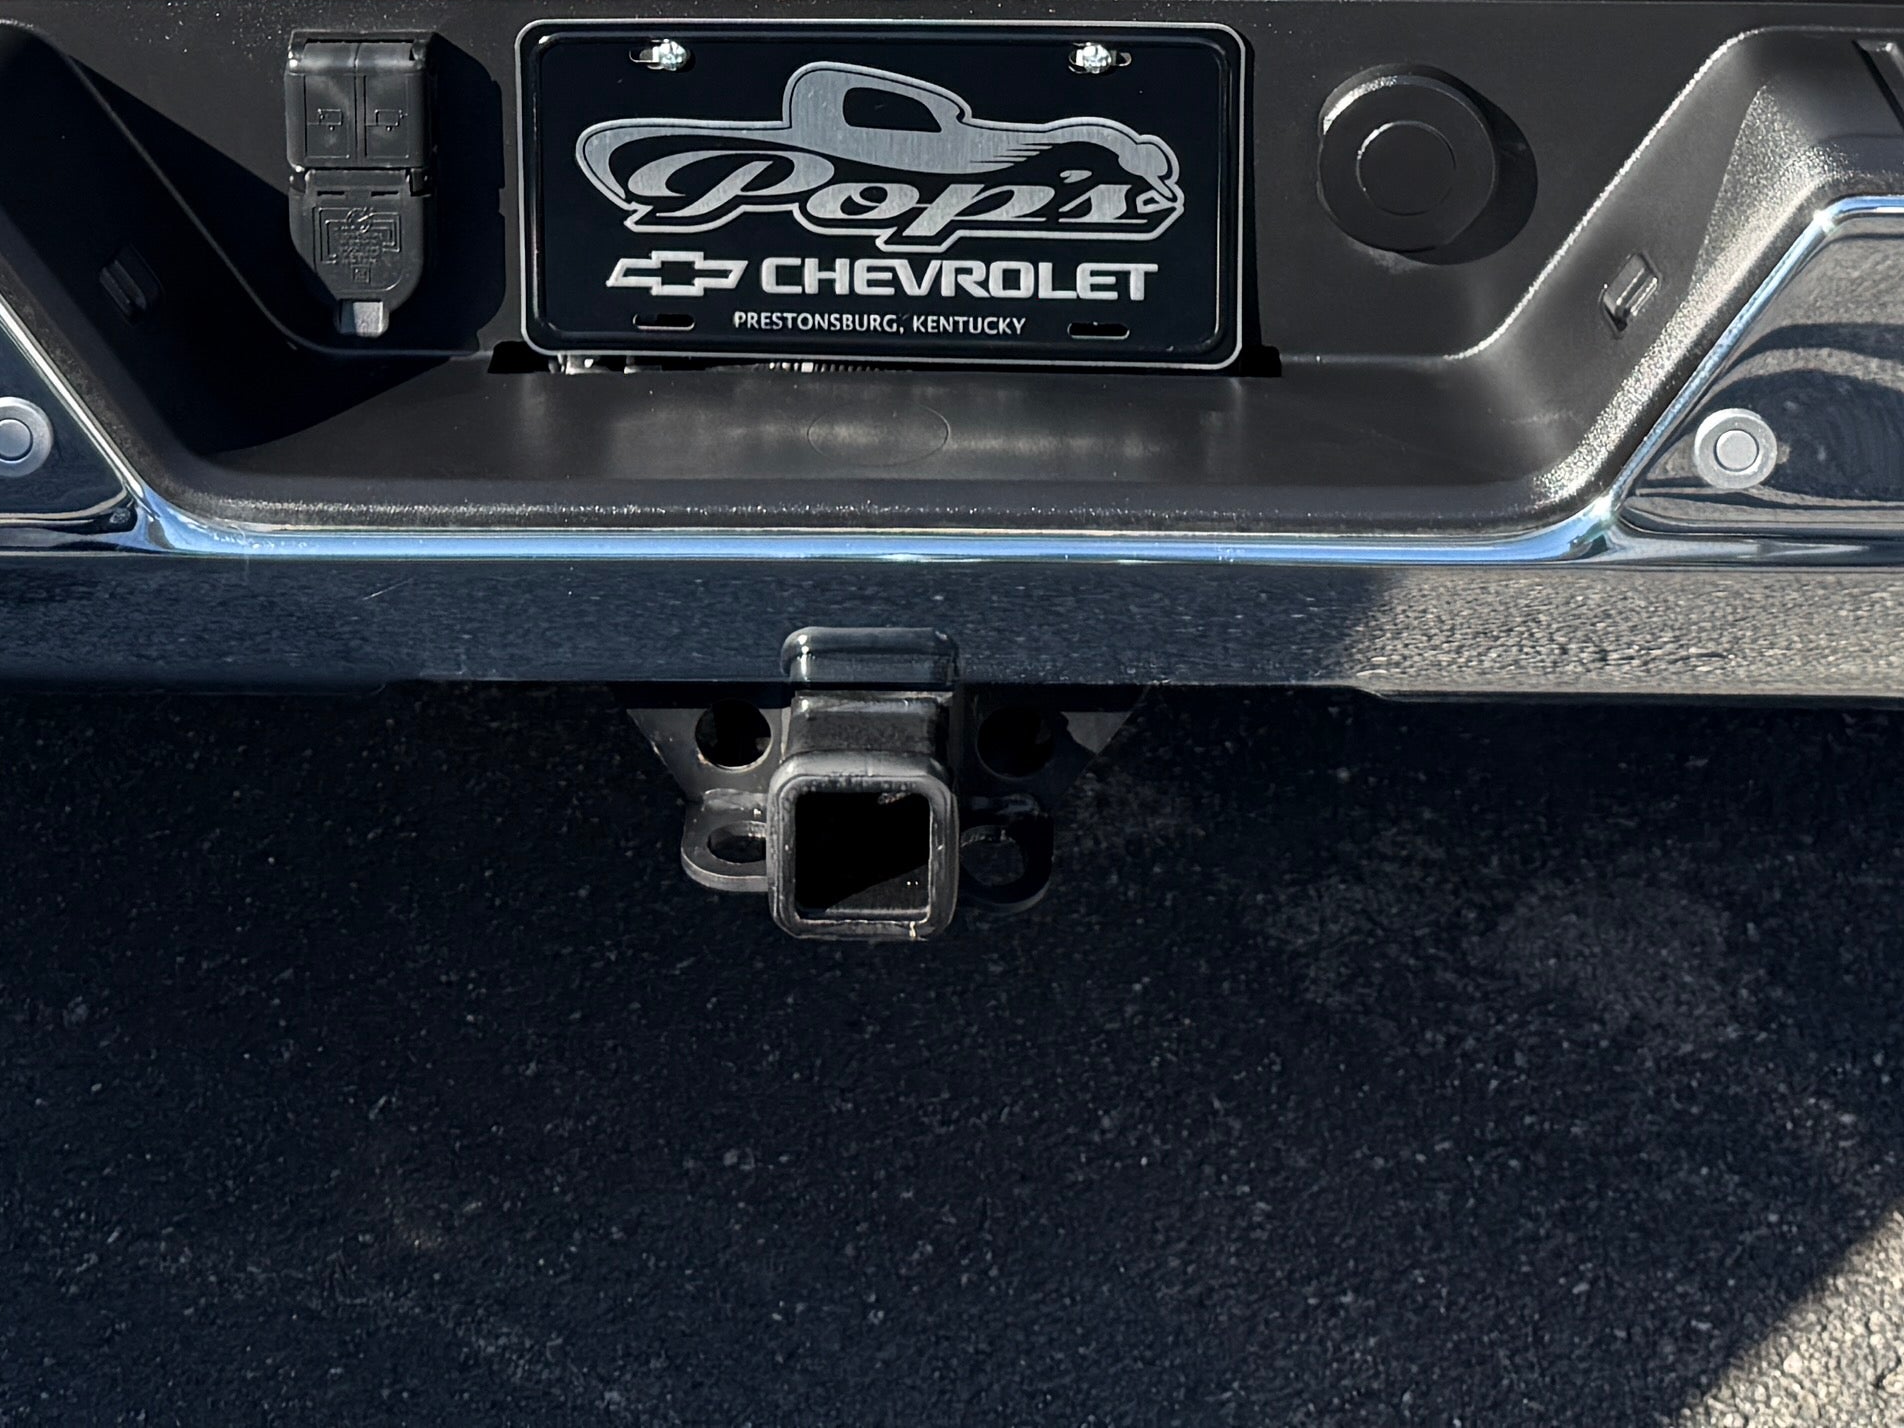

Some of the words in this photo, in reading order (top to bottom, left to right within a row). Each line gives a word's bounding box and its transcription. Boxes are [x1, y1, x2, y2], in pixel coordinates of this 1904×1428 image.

[627, 149, 1151, 238] Pop's
[760, 255, 1159, 301] CHEVROLET
[732, 309, 907, 335] PRESTONSBURG,
[911, 314, 1028, 336] KENTUCKY
